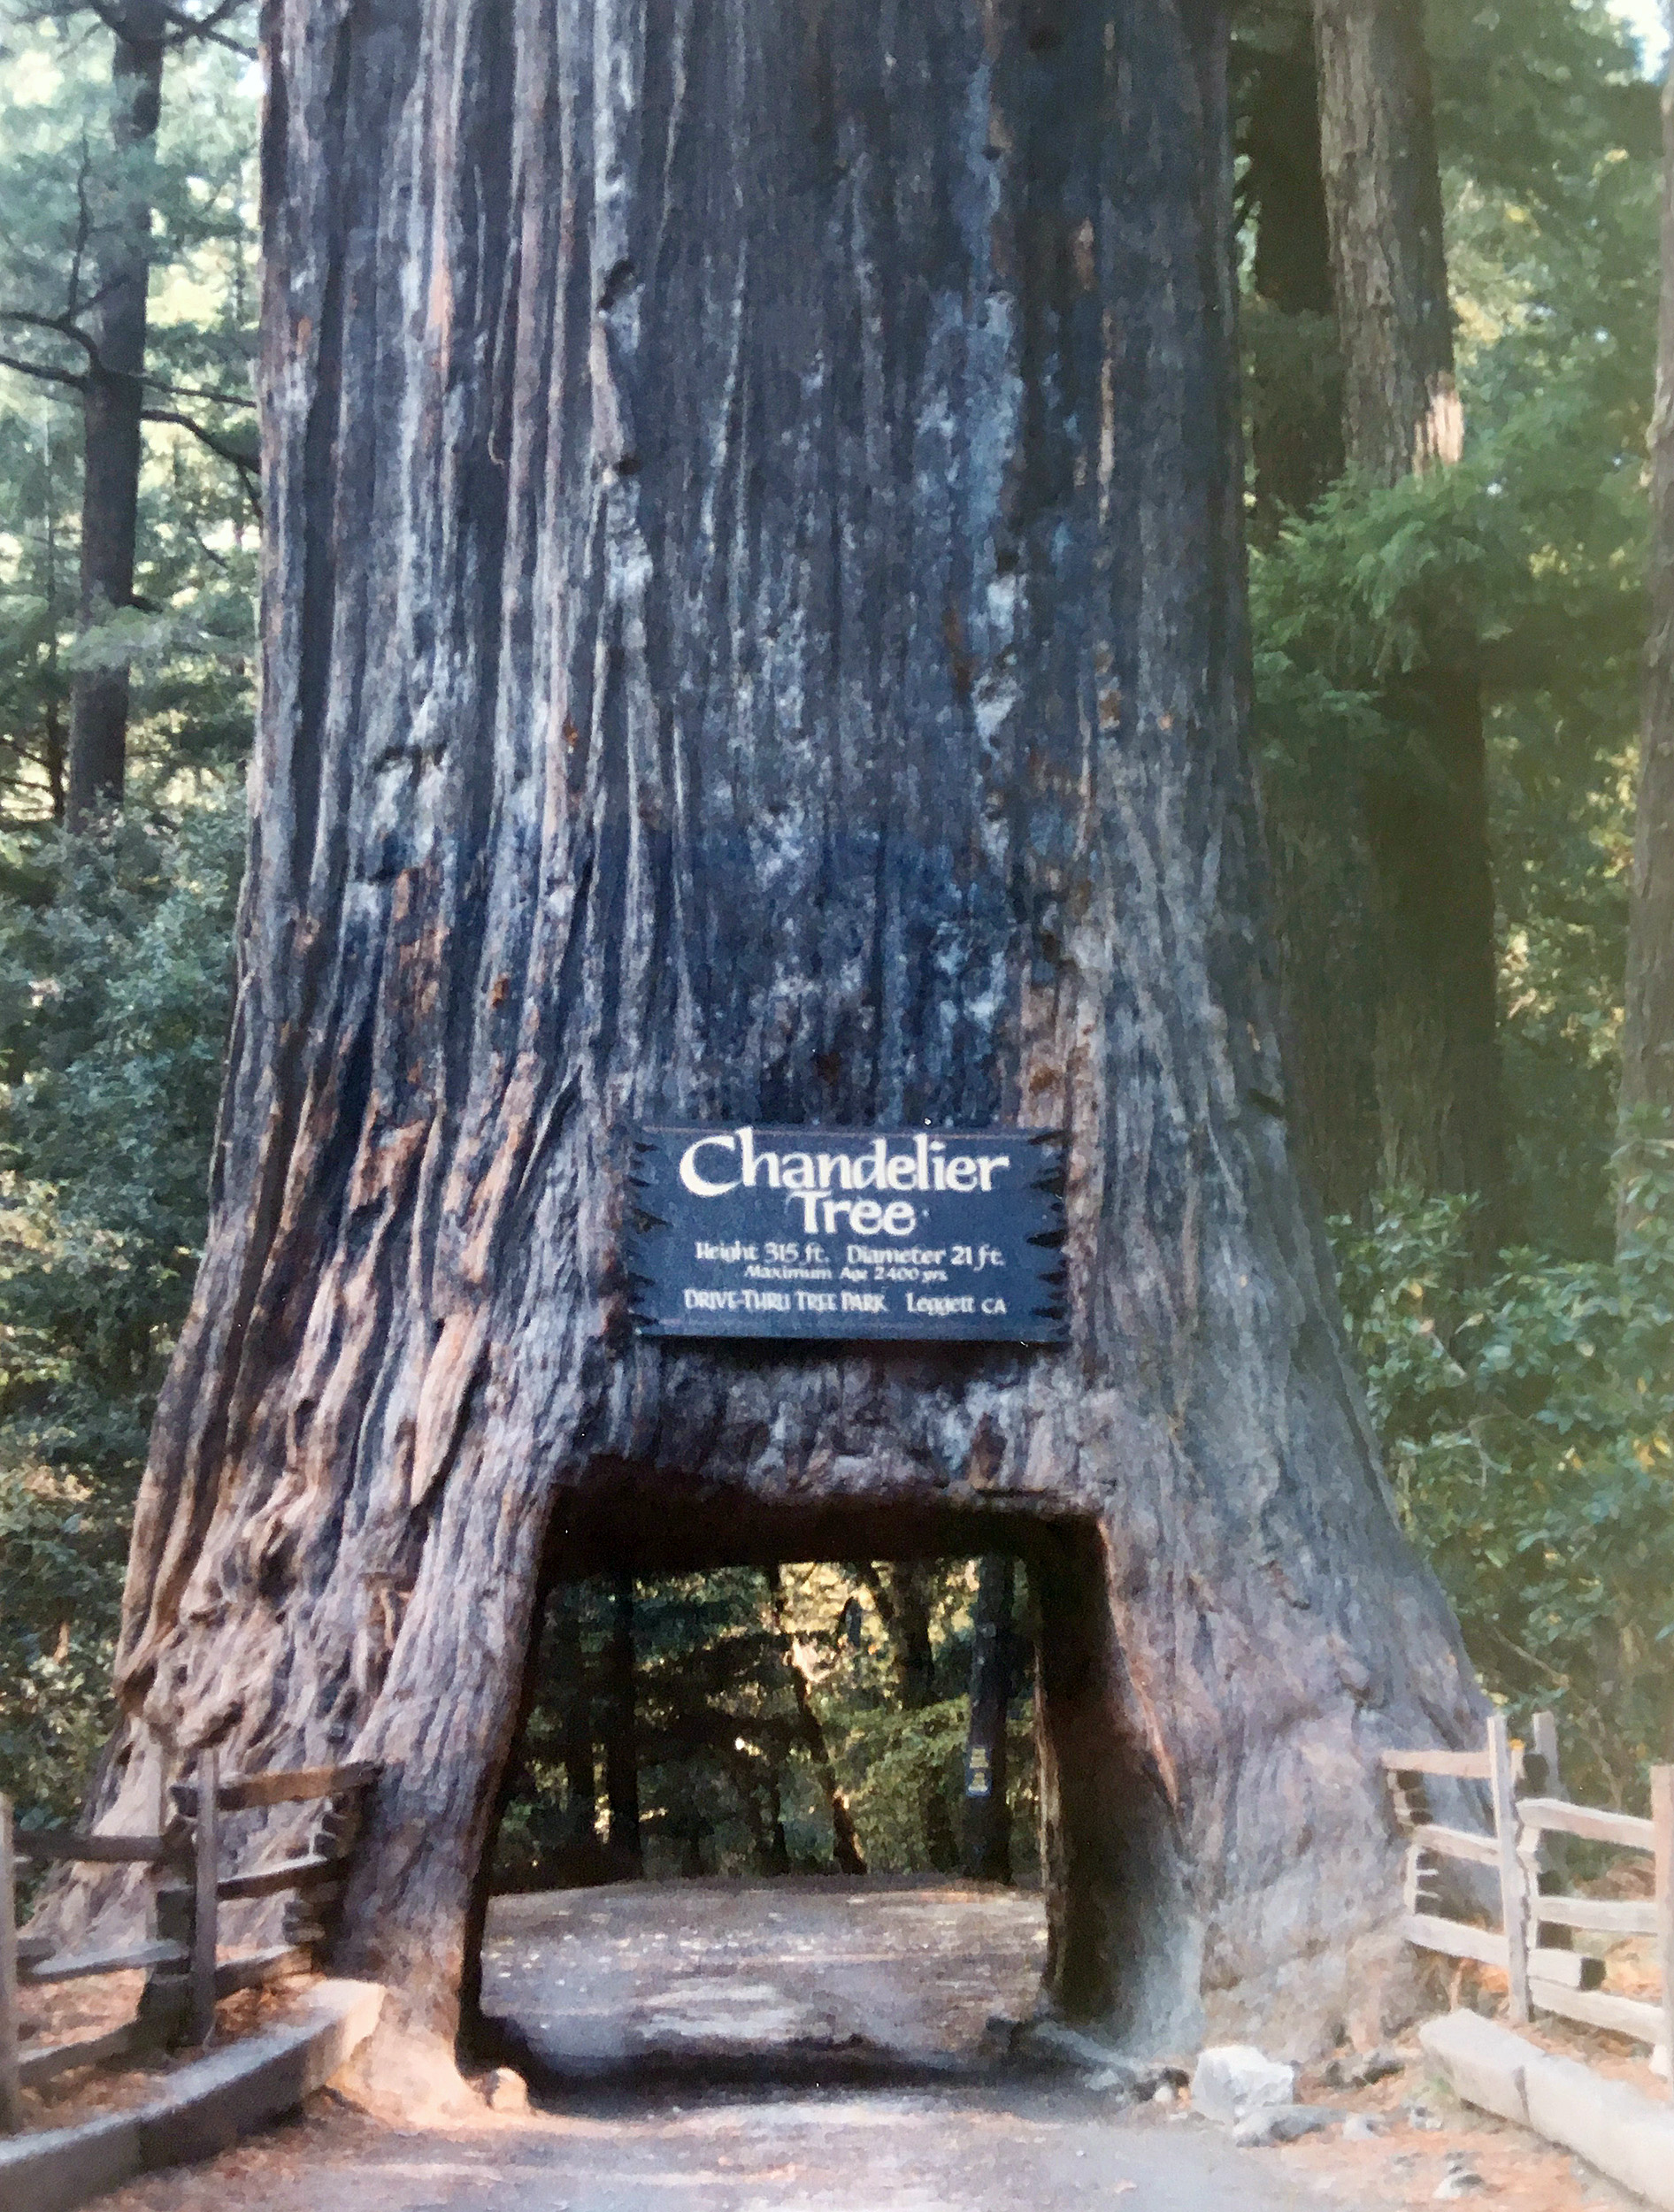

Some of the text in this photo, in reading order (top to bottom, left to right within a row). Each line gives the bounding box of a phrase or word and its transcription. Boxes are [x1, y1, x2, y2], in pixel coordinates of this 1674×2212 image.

[679, 1125, 1010, 1196] Chandelier
[784, 1189, 917, 1236] Tree
[695, 1240, 758, 1263] Height
[764, 1241, 800, 1263] 315
[846, 1244, 947, 1265] Diameter
[950, 1245, 972, 1265] 21
[974, 1243, 1005, 1271] ft.
[744, 1265, 832, 1279] Maximum
[684, 1288, 1007, 1316] DRIVE-THRU TREE PARK Leggett CA
